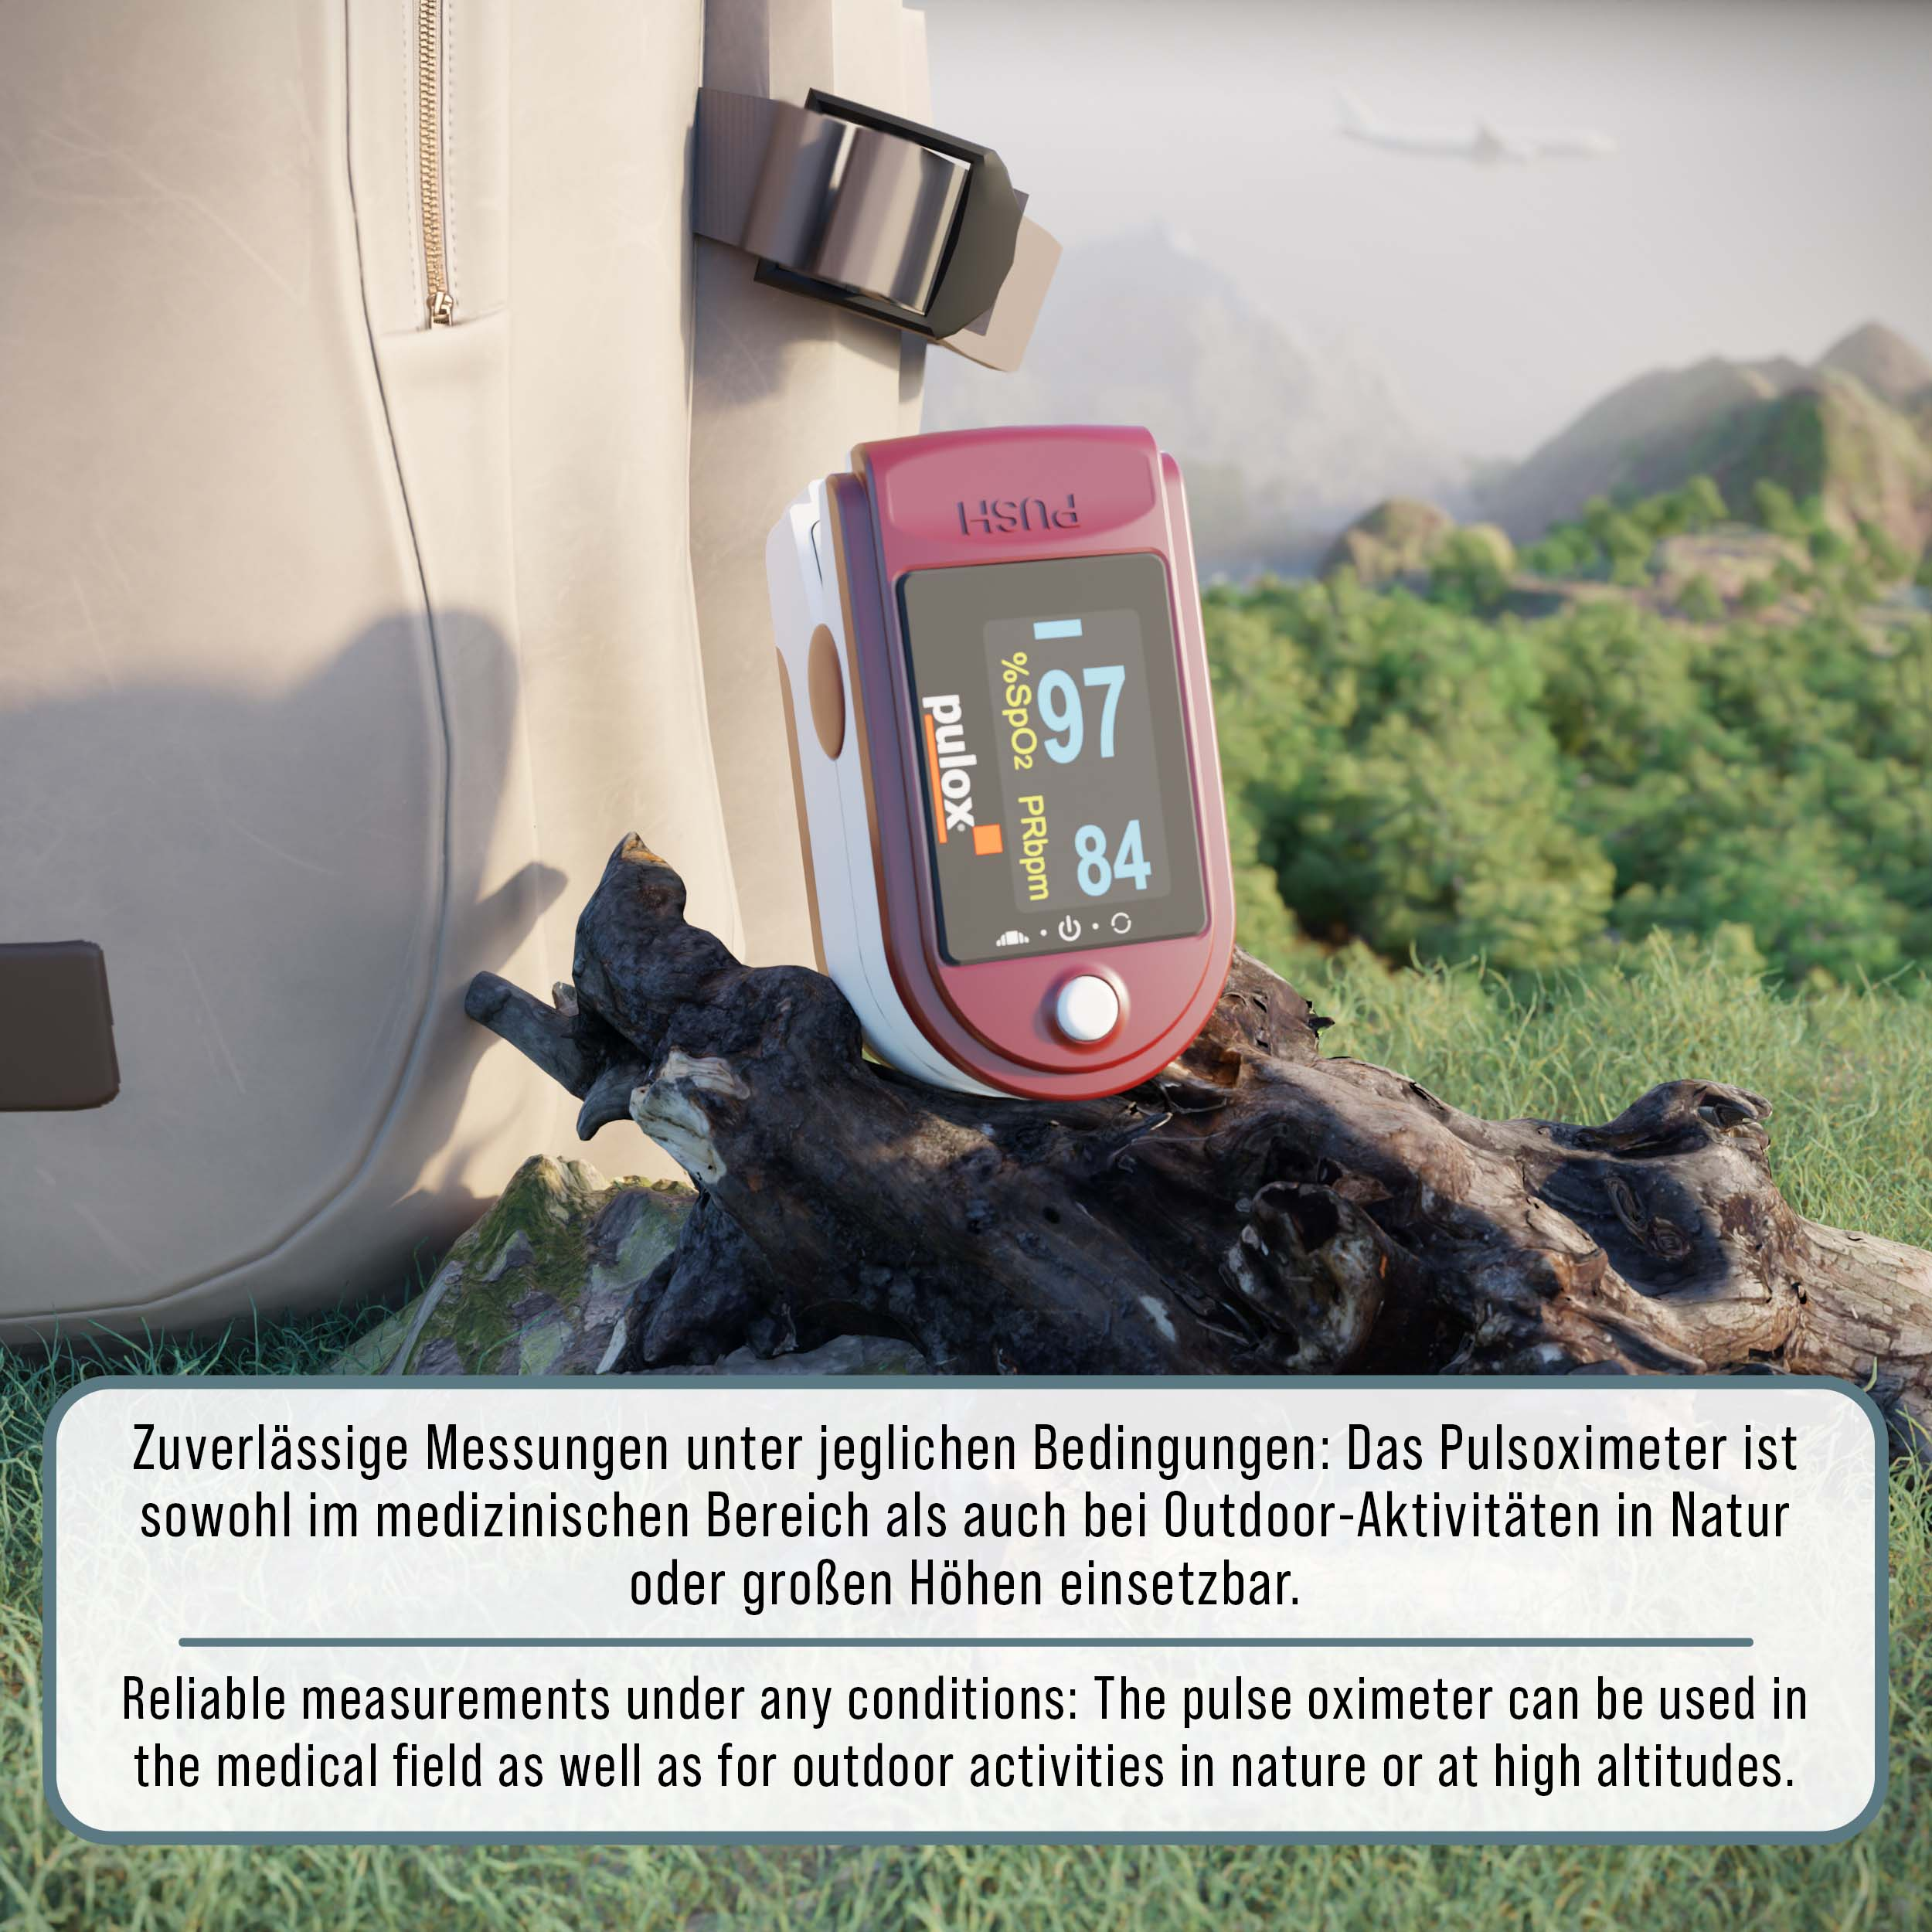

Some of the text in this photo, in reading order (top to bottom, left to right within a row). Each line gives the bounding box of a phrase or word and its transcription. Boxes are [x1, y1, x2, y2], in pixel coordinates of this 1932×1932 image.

[957, 493, 1080, 536] PUSH
[1037, 666, 1125, 764] 97
[1017, 794, 1050, 901] PRbpm
[1075, 820, 1151, 896] 84
